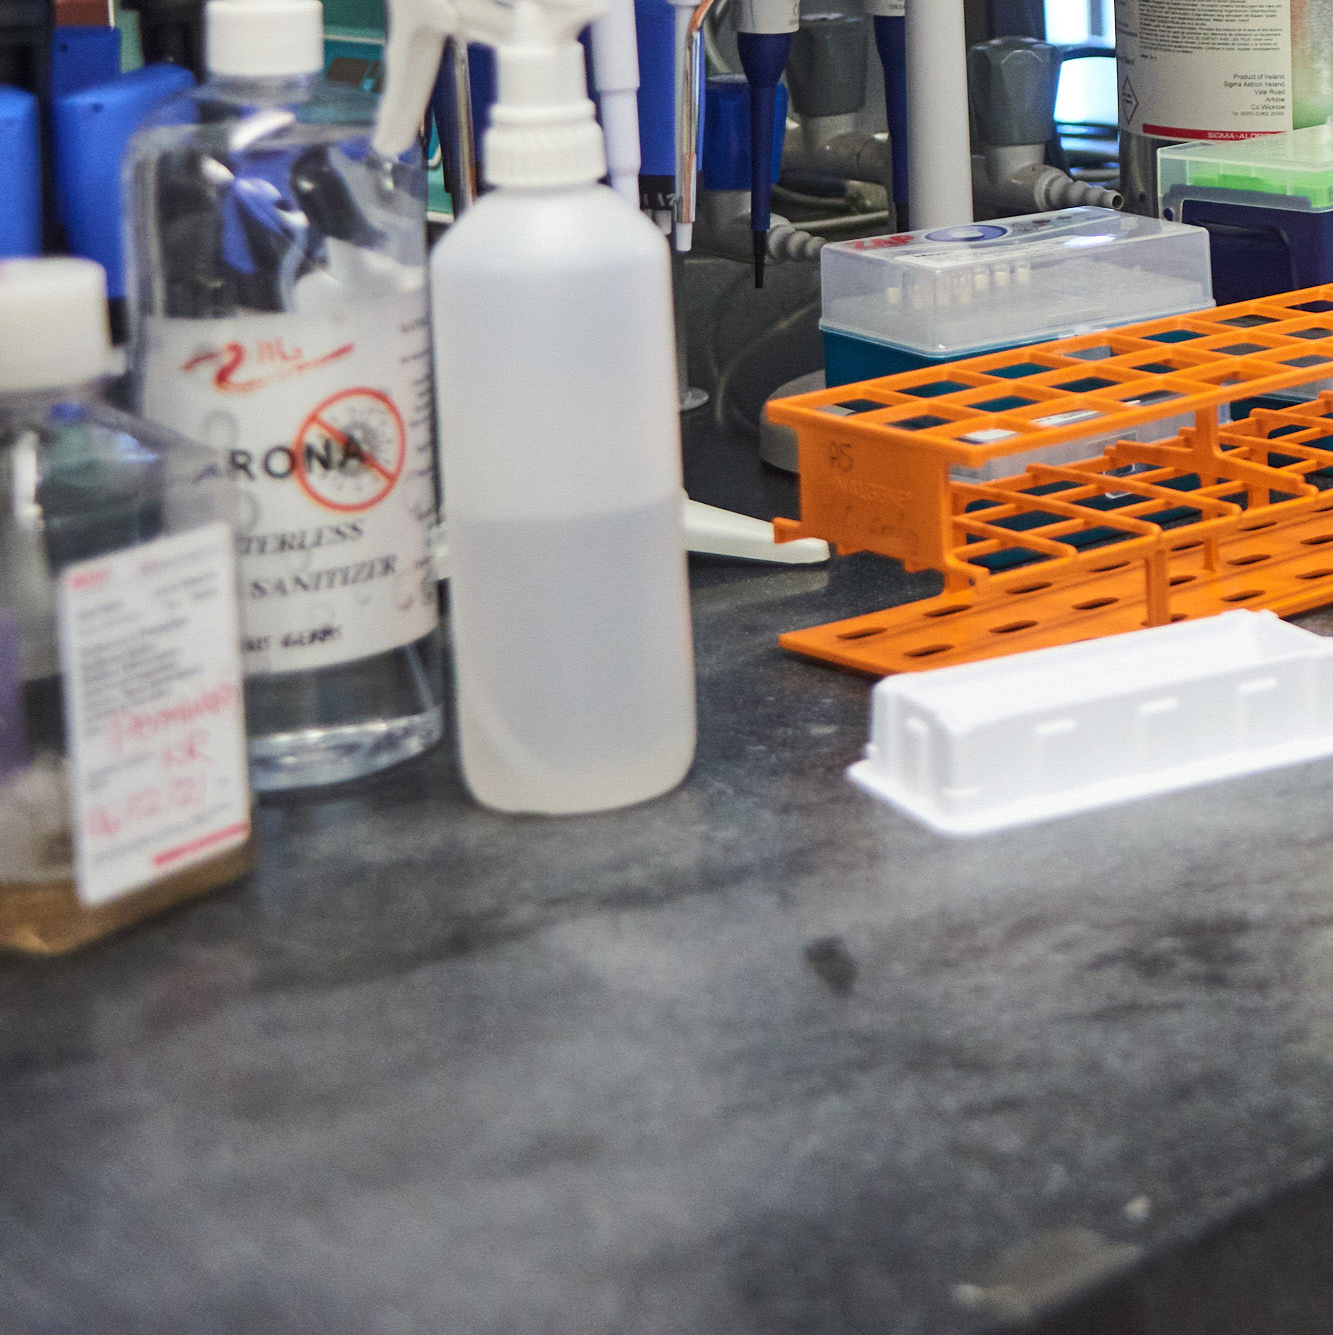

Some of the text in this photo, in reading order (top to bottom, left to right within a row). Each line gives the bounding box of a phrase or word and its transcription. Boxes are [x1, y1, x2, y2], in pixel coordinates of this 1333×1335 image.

[1224, 81, 1242, 89] Sigma
[1233, 73, 1256, 81] Product
[227, 435, 366, 484] RONA
[250, 553, 398, 601] SANITIZER
